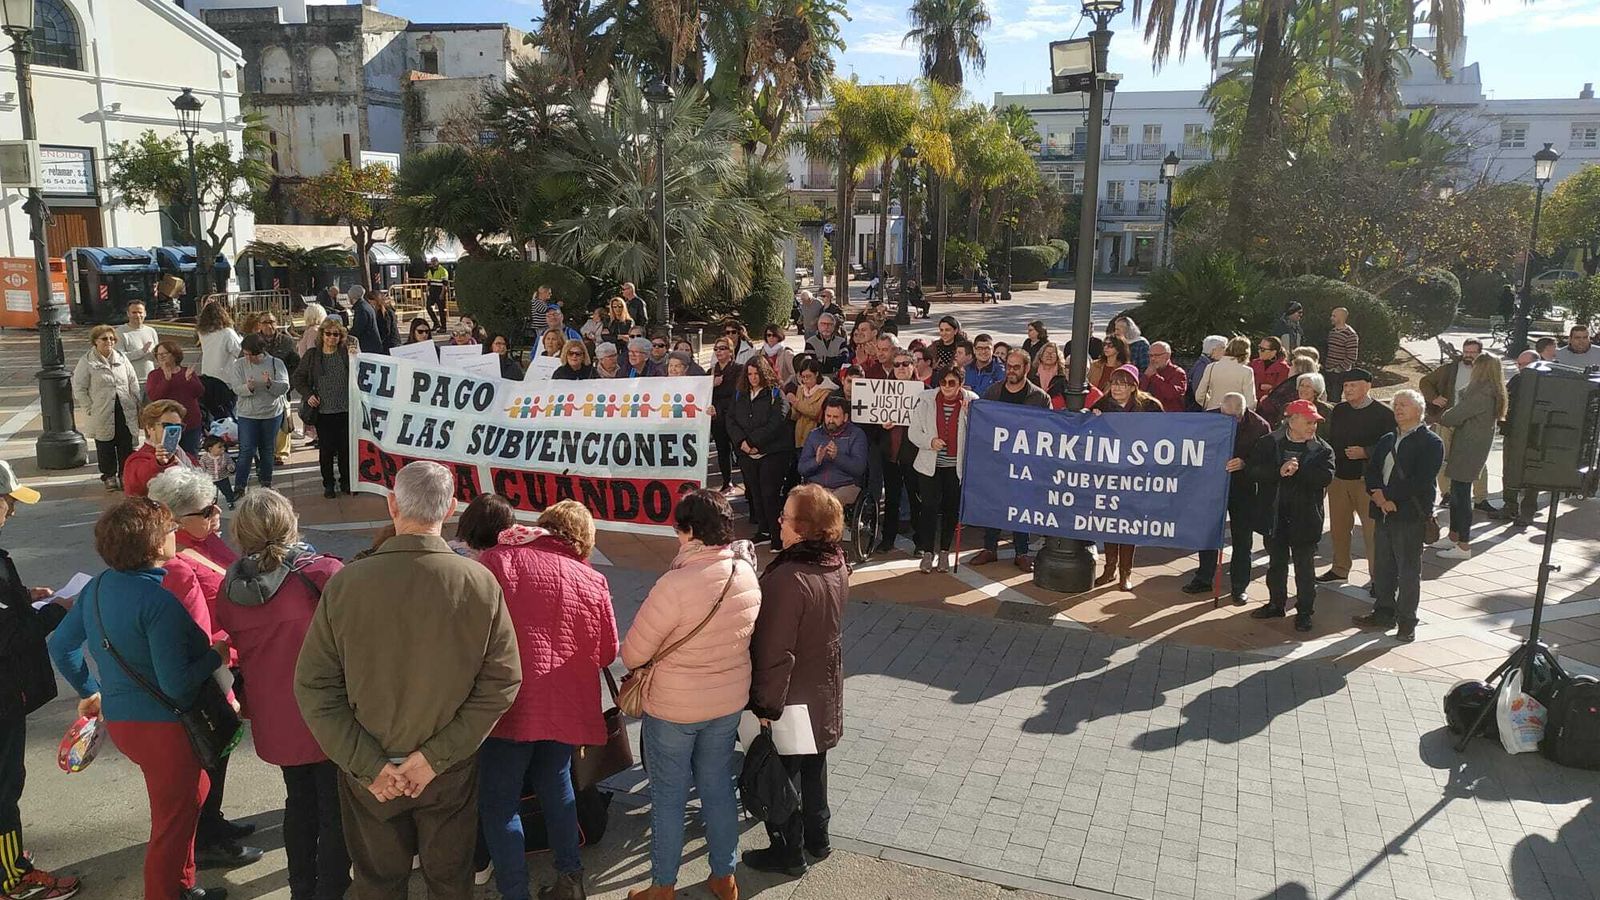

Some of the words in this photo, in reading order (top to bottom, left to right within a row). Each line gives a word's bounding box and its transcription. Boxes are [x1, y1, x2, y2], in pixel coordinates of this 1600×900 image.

[40, 150, 87, 159] ENDIDO
[357, 361, 395, 398] EL
[410, 371, 495, 412] PAGO
[870, 380, 905, 395] VINO
[869, 408, 911, 424] SOCIA
[397, 413, 455, 450] LAS
[466, 423, 698, 468] SUBVENCIONES
[1009, 463, 1033, 481] LA
[1048, 490, 1075, 507] NO
[1095, 494, 1120, 511] ES
[1007, 506, 1059, 528] PARA
